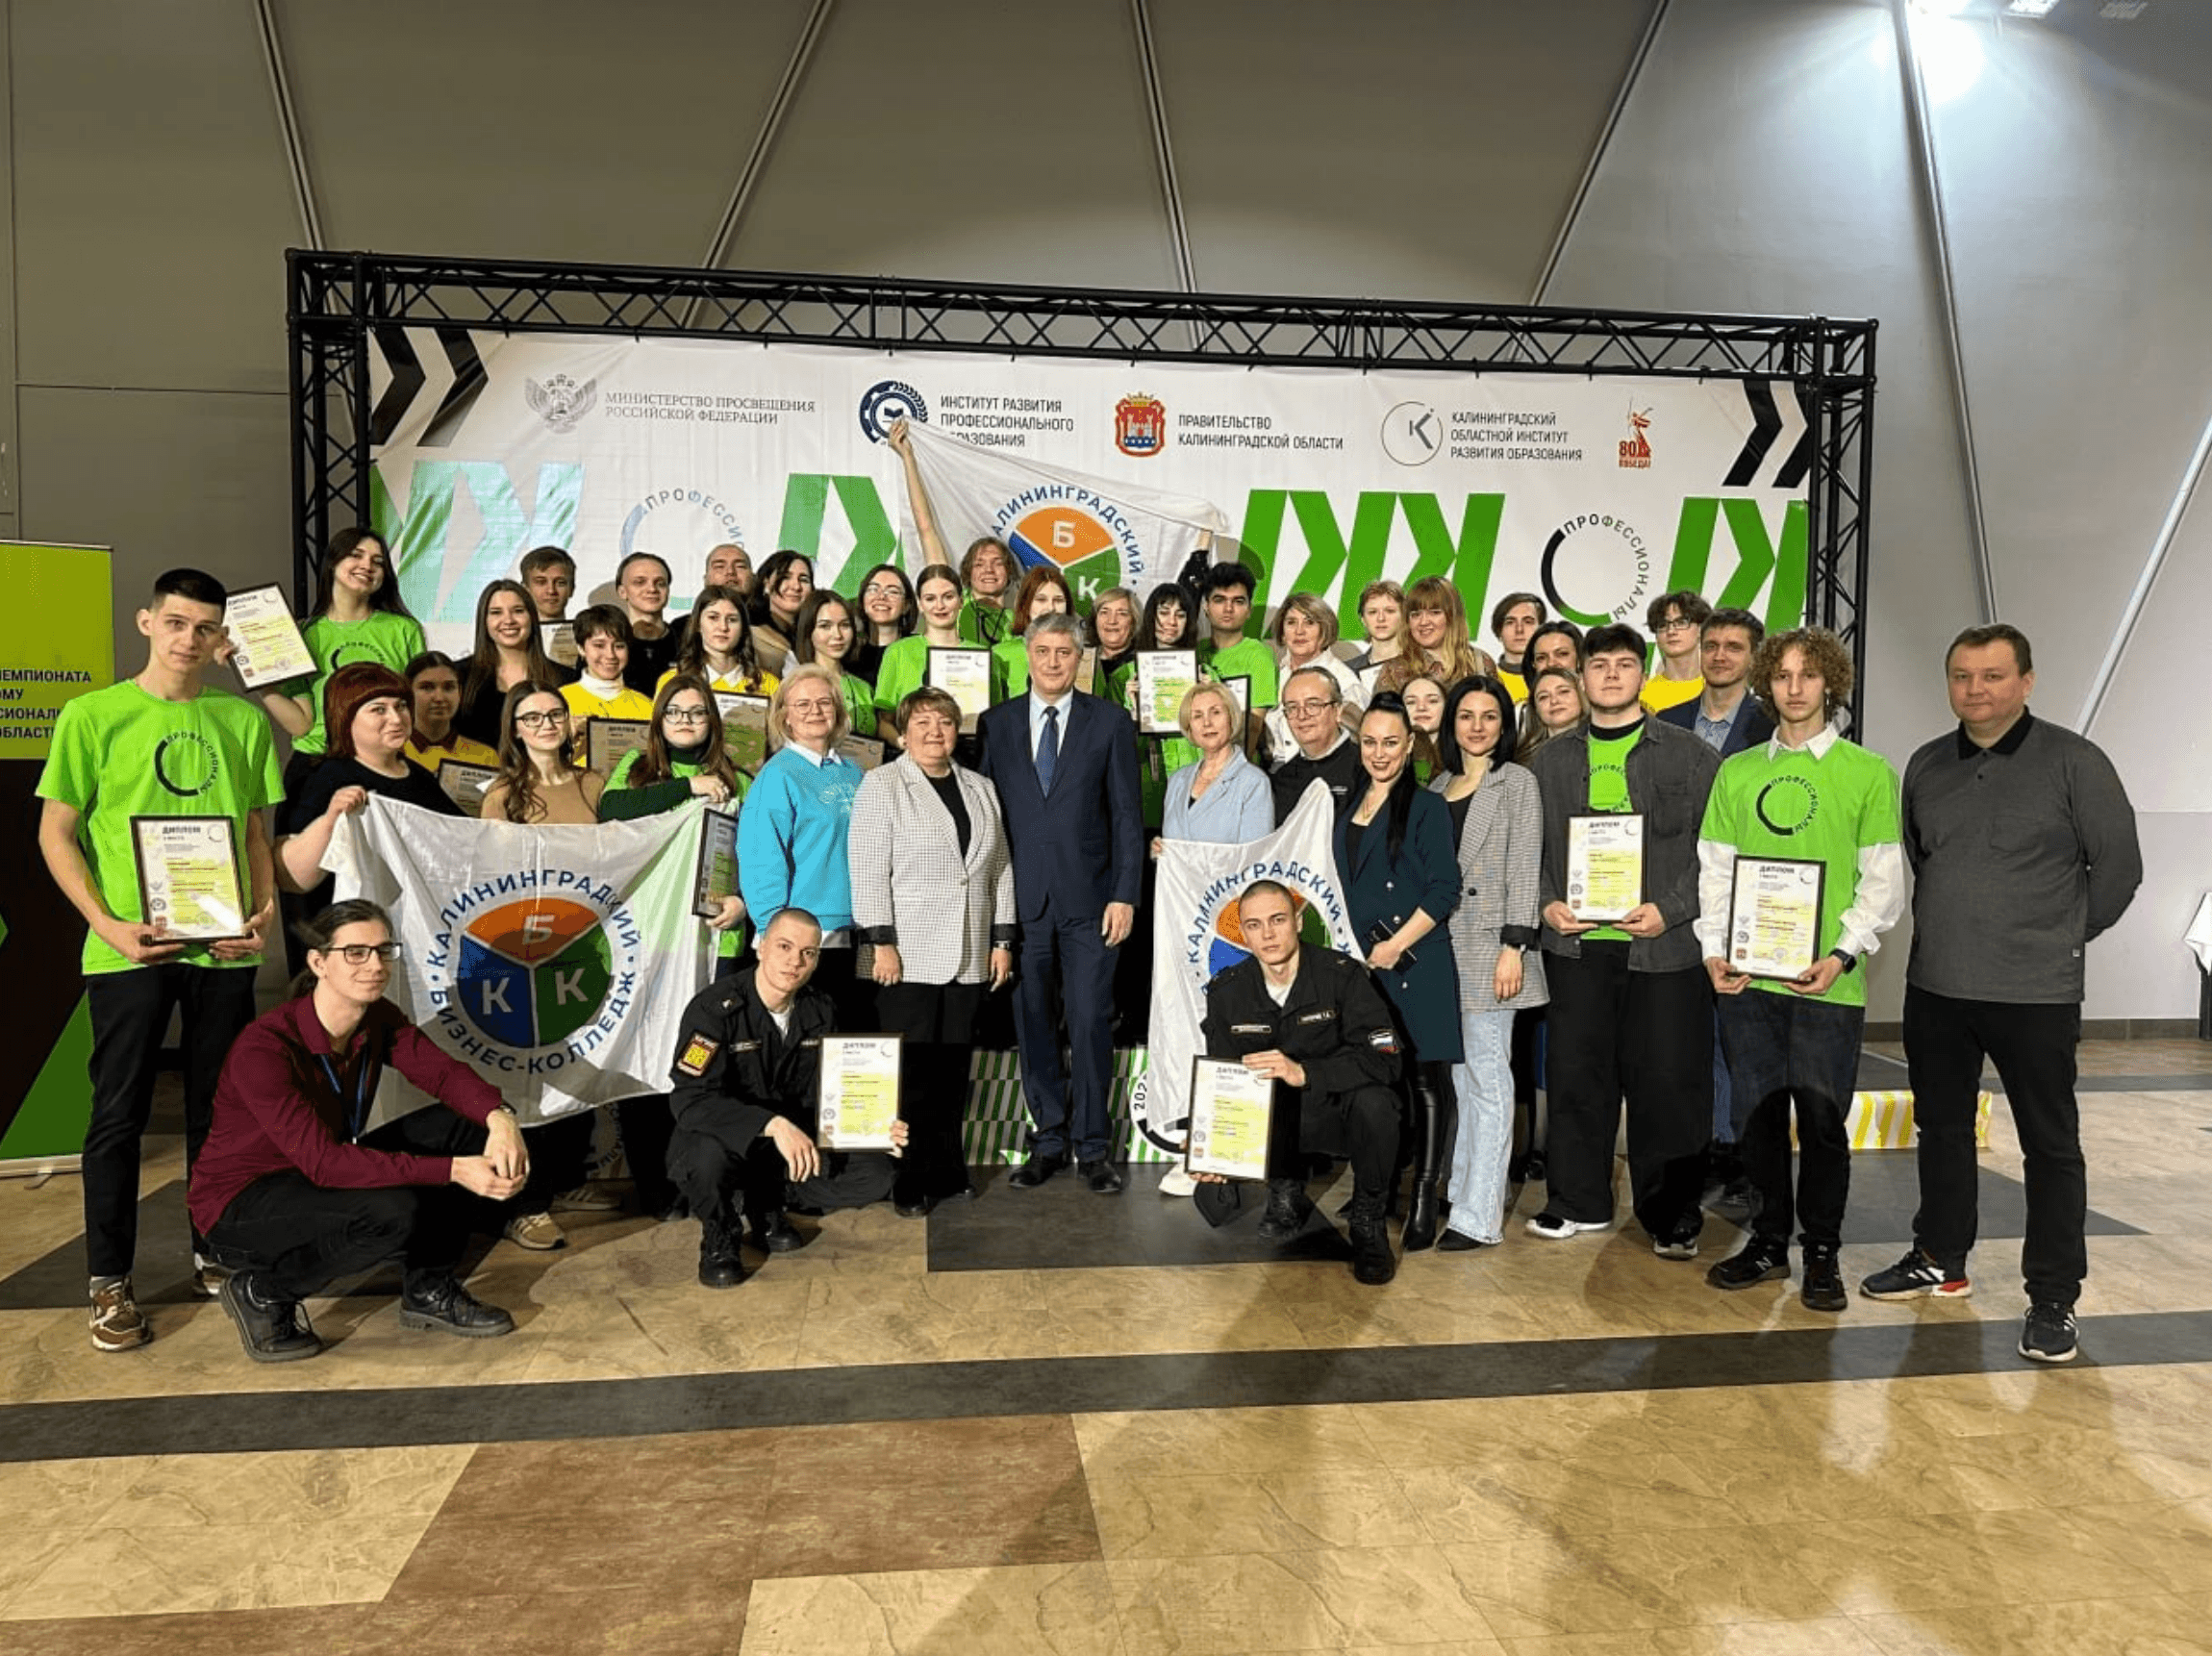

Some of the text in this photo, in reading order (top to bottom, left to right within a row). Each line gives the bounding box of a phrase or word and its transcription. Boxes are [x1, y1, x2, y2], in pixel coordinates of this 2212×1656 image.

[605, 391, 816, 413] МИНИСТЕРСТВО ПРОСВЕЩЕНИЯ
[940, 395, 1062, 414] ИНСТИТУТ РАЗВИТИЯ
[605, 406, 778, 425] РОССИЙСКОЙ ФЕДЕРАЦИИ
[940, 413, 1074, 432] ПРОФЕССИОНАЛЬНОГО
[1178, 414, 1272, 430] ПРАВИТЕЛЬСТВО
[1451, 411, 1557, 427] КАЛИНИНГРАДСКИЙ
[1177, 434, 1344, 451] КАЛИНИНГРАДСКОЙ ОБЛАСТИ
[1450, 429, 1569, 443] ОБЛАСТНОЙ ИНСТИТУТ
[1450, 446, 1583, 462] РАЗВИТИЯ ОБРАЗОВАНИЯ
[992, 485, 1144, 574] АЛИНИНГРАДСКИЙ
[1563, 513, 1649, 620] ПРОФЕССИОНАЛЫ
[0, 669, 91, 683] ЕМПИОНАТА
[0, 688, 24, 701] МУ
[482, 968, 589, 1015] К К
